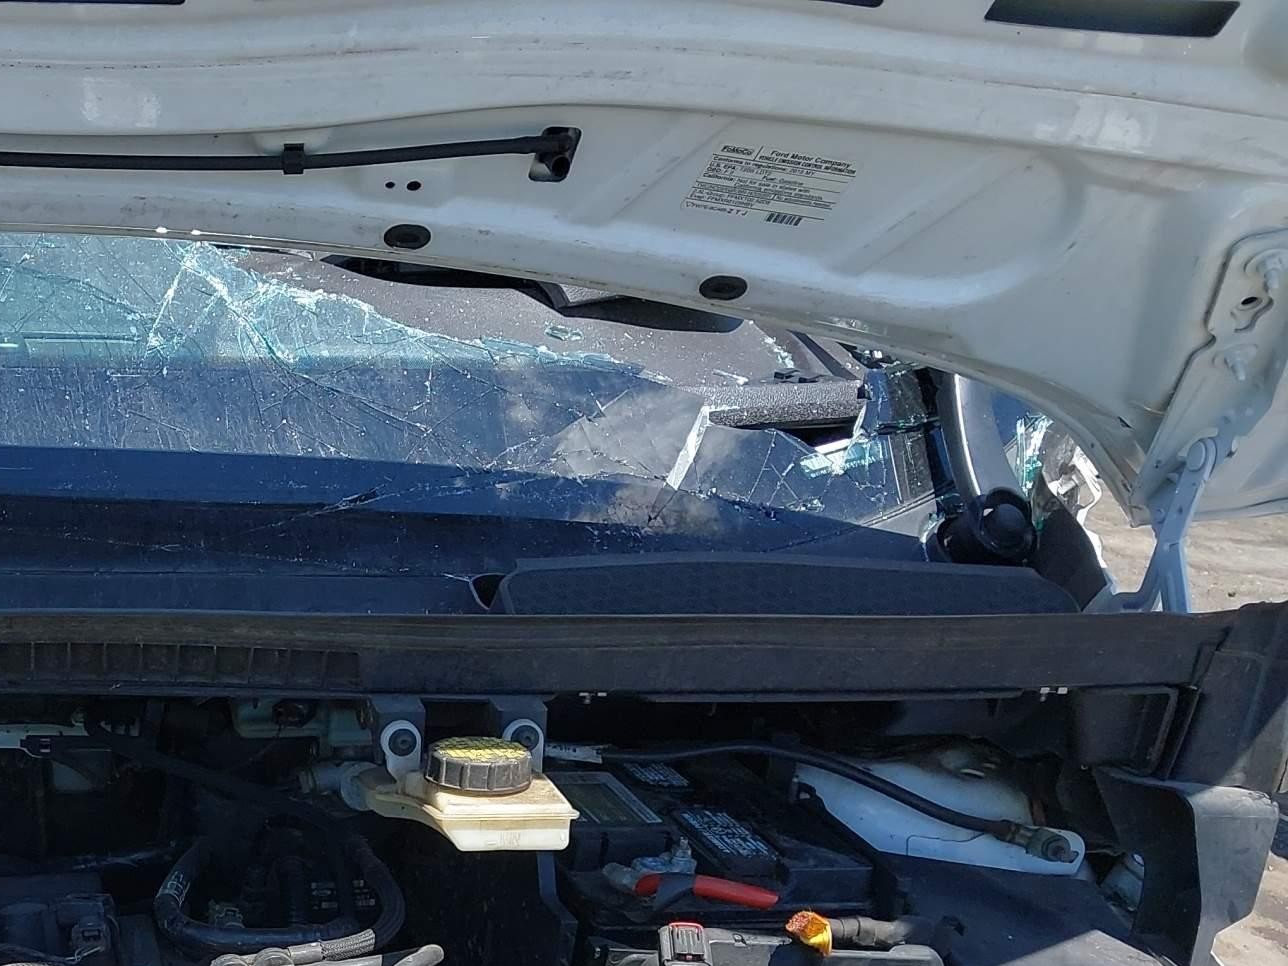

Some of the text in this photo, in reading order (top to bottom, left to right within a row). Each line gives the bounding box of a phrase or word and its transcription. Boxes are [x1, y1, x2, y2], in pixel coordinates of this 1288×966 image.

[770, 150, 851, 168] Ford Motor Company
